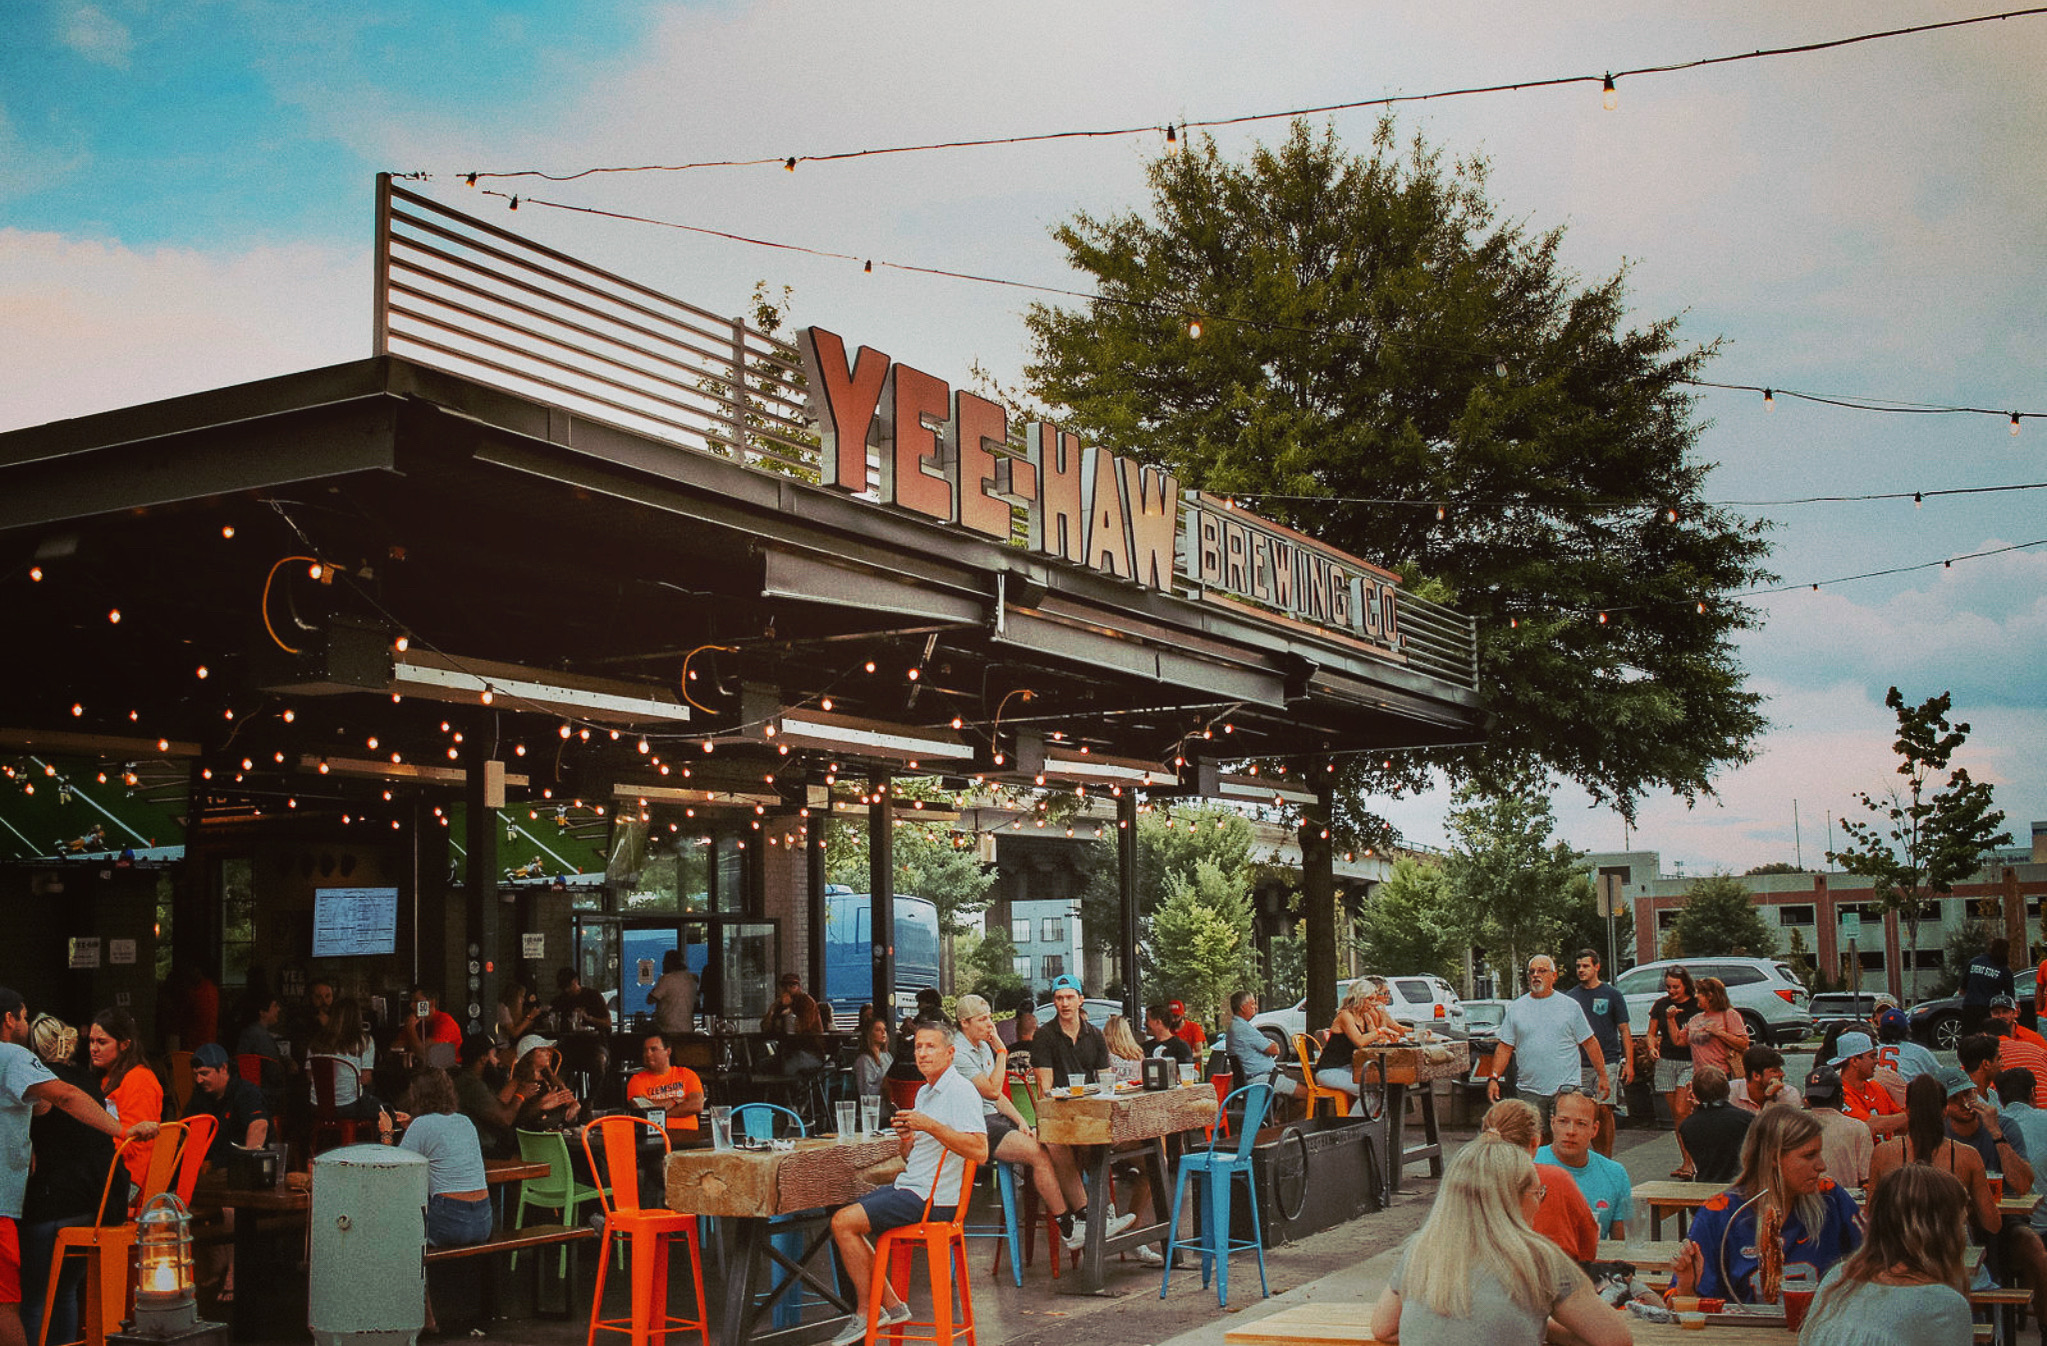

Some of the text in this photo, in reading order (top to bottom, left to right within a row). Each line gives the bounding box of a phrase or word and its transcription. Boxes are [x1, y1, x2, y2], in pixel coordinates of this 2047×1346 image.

[802, 325, 1180, 594] YEE-HAW
[1197, 508, 1348, 627] BREWING
[647, 1081, 685, 1096] CLEMSON
